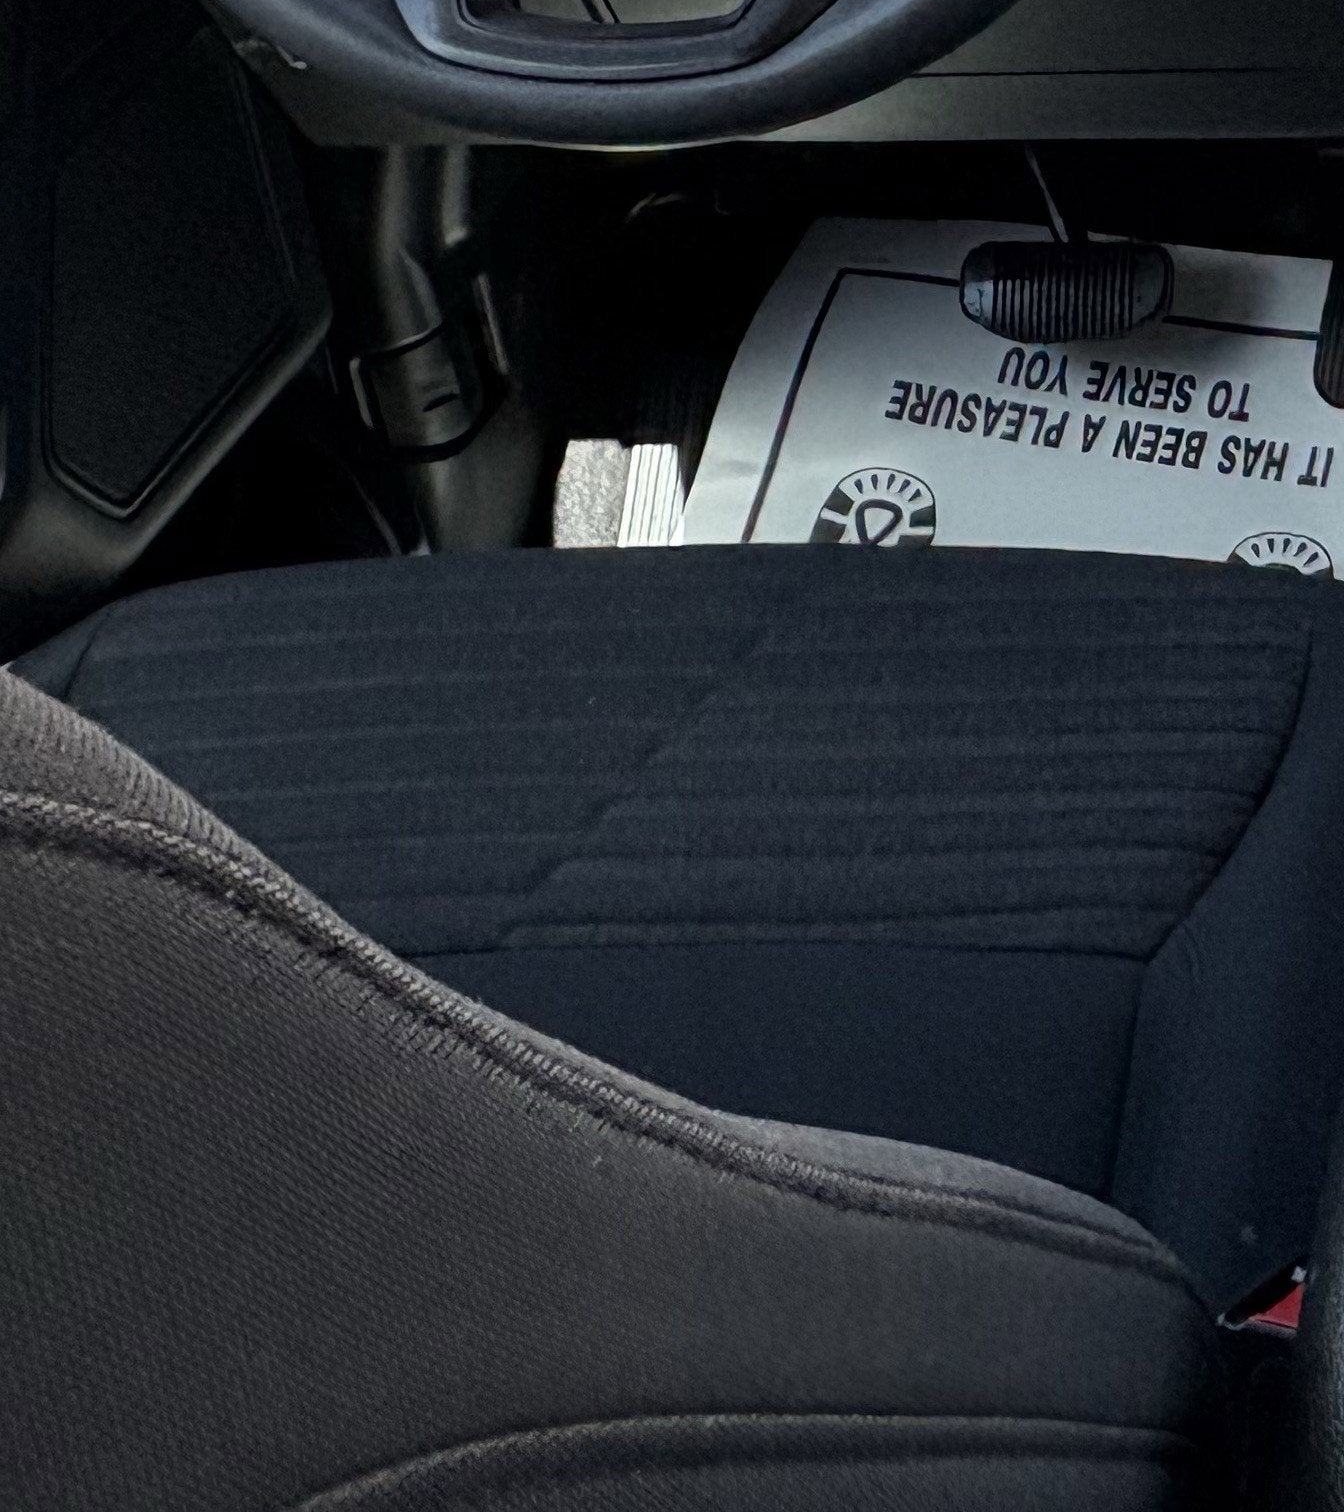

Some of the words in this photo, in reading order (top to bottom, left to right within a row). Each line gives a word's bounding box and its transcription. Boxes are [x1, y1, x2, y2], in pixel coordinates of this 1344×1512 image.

[997, 346, 1069, 397] YOU
[1082, 360, 1197, 414] SERVE
[884, 379, 1071, 449] PLEASURE
[1206, 379, 1251, 423] TO
[1080, 413, 1108, 454] A
[1112, 419, 1208, 470] BEEN
[1216, 434, 1290, 482] HAS
[1297, 445, 1335, 488] IT
